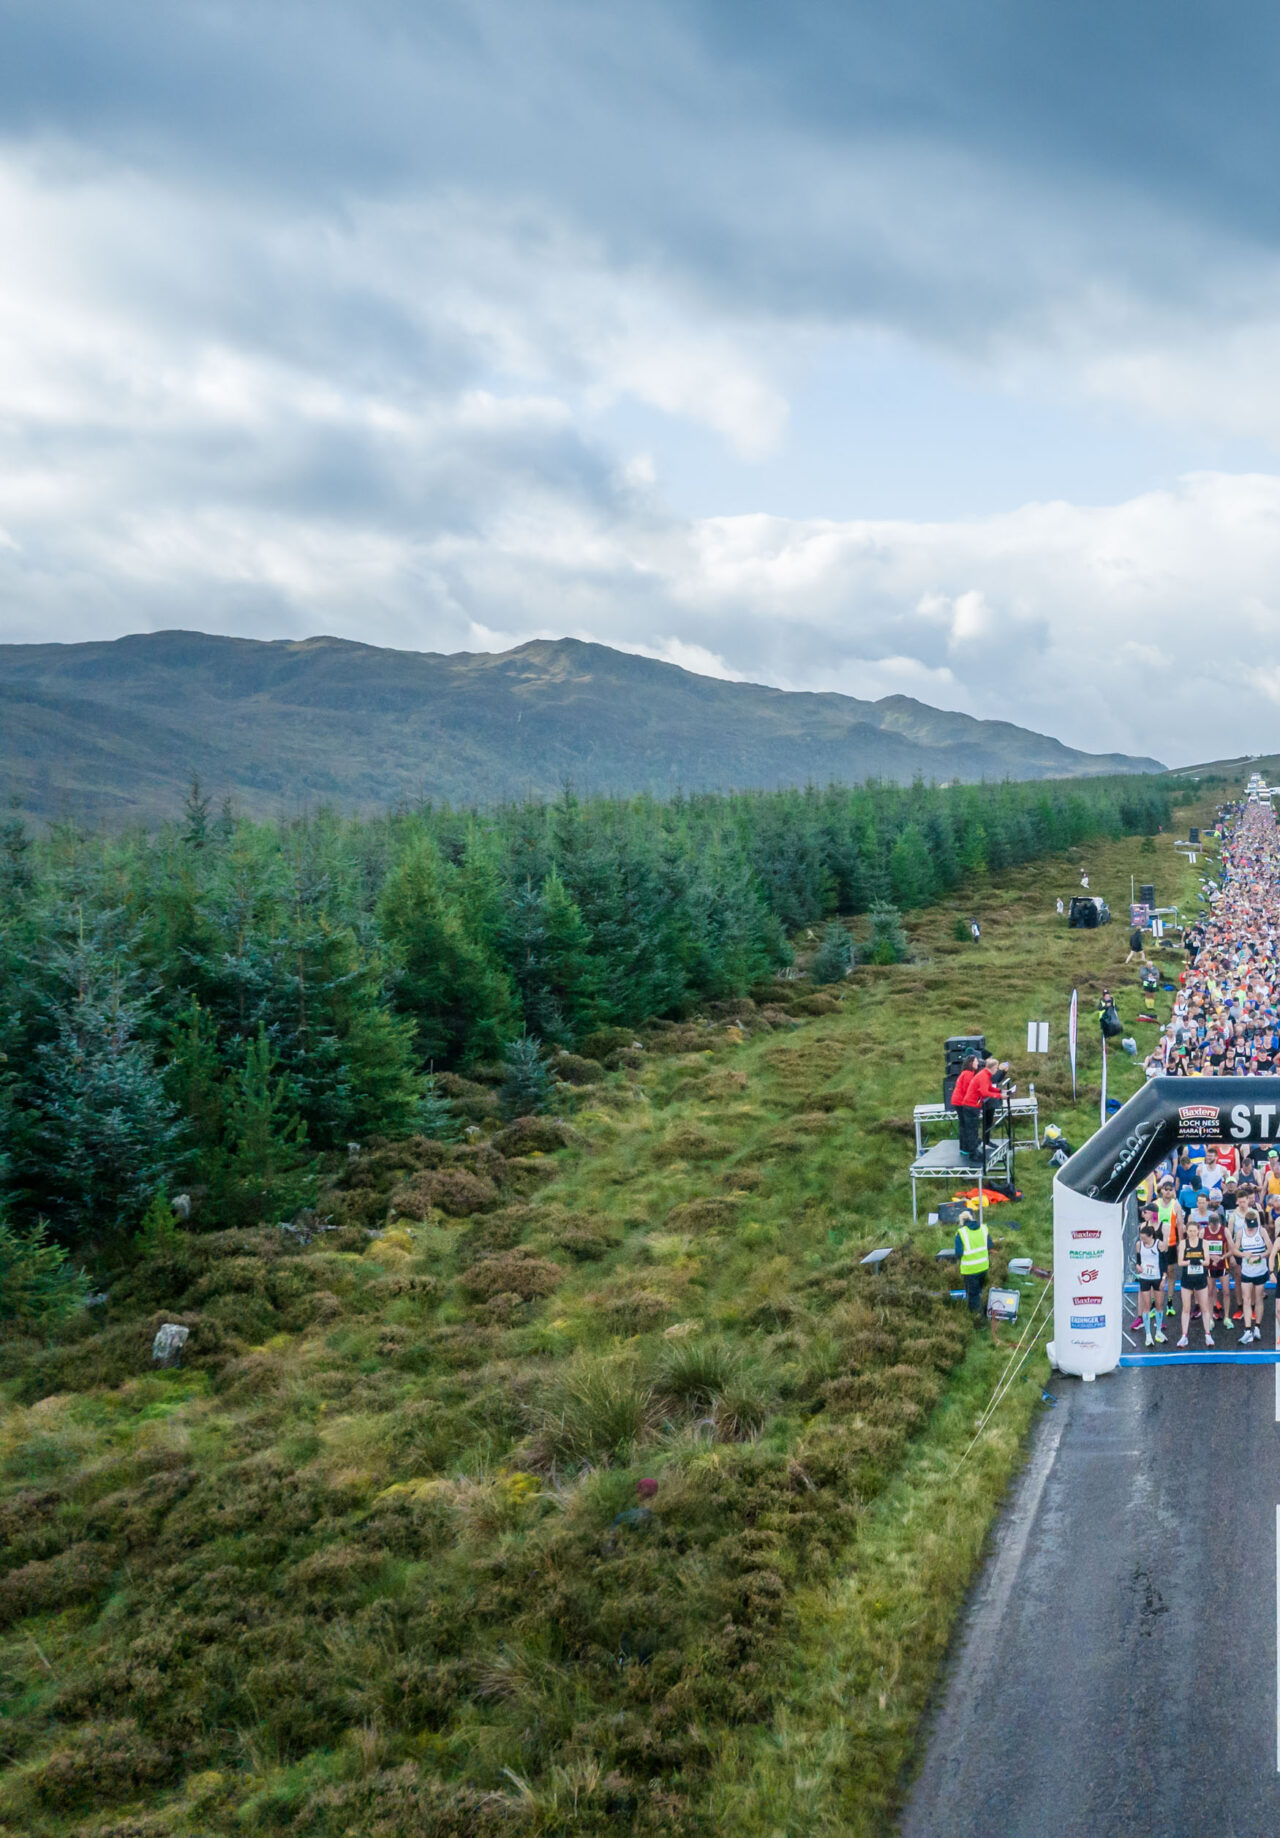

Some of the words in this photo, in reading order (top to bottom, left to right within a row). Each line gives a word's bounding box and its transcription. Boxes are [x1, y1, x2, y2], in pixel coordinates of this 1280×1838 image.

[1182, 1107, 1217, 1117] Baxters
[1179, 1119, 1200, 1127] LOCH
[1201, 1119, 1220, 1127] NESS
